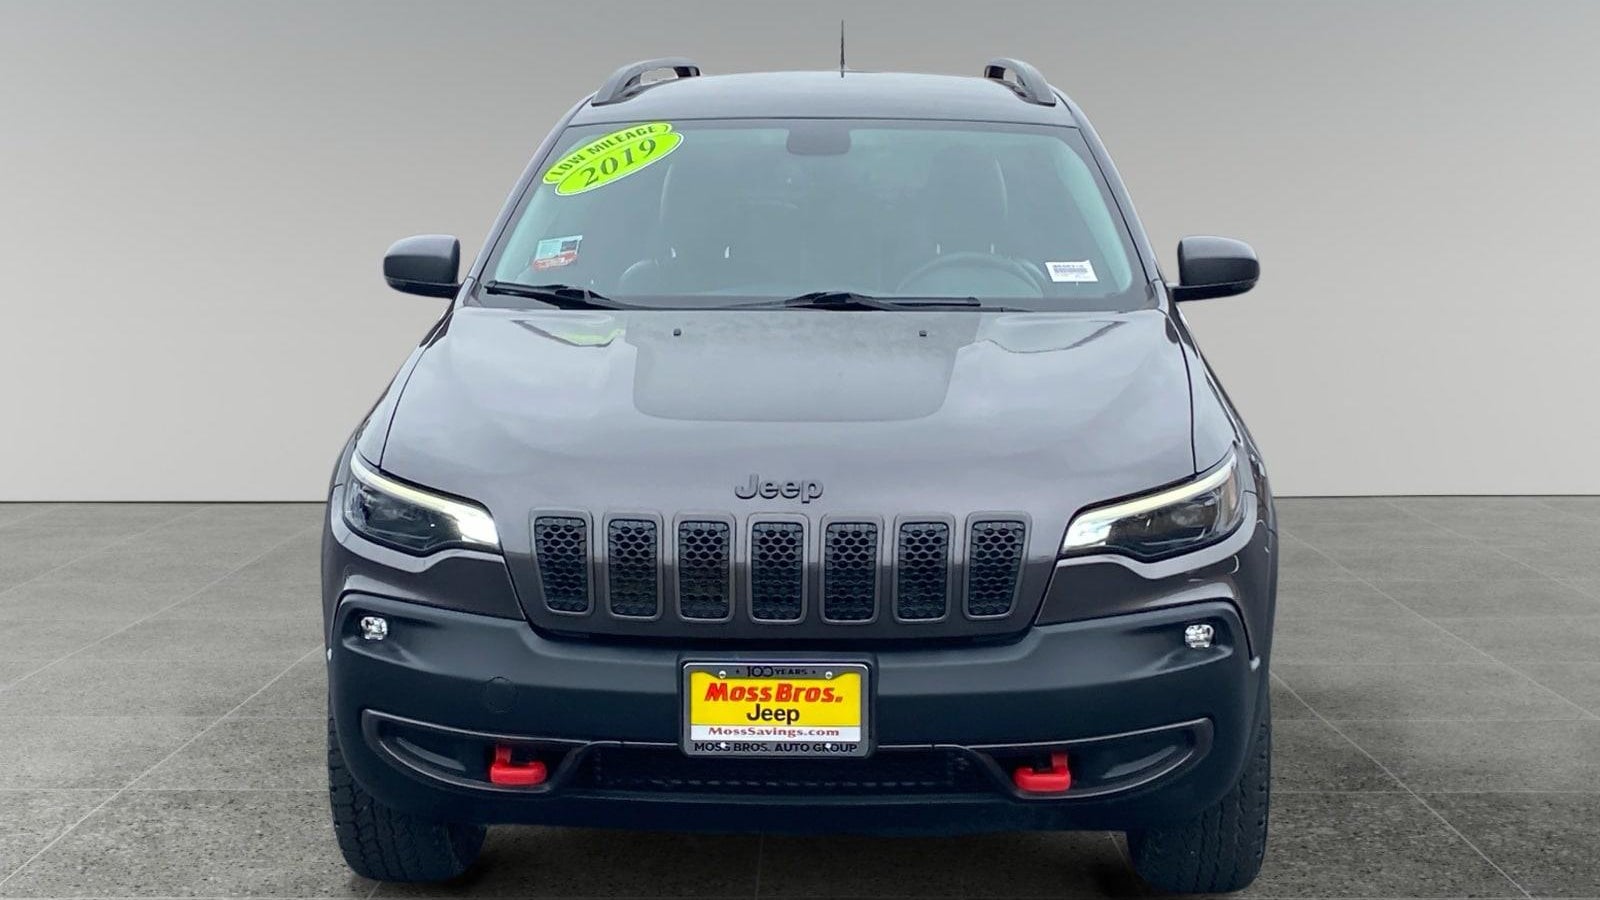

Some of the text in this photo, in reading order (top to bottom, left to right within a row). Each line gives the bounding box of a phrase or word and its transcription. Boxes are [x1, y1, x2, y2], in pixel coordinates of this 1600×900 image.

[551, 126, 656, 176] LOW MILEAGE
[580, 139, 656, 188] 2019
[734, 473, 824, 504] Jeep
[704, 682, 843, 703] Moss Bros.
[746, 703, 800, 725] Jeep
[708, 727, 840, 738] MossSavings.com
[774, 743, 810, 752] AUTO
[812, 743, 858, 753] GROUP
